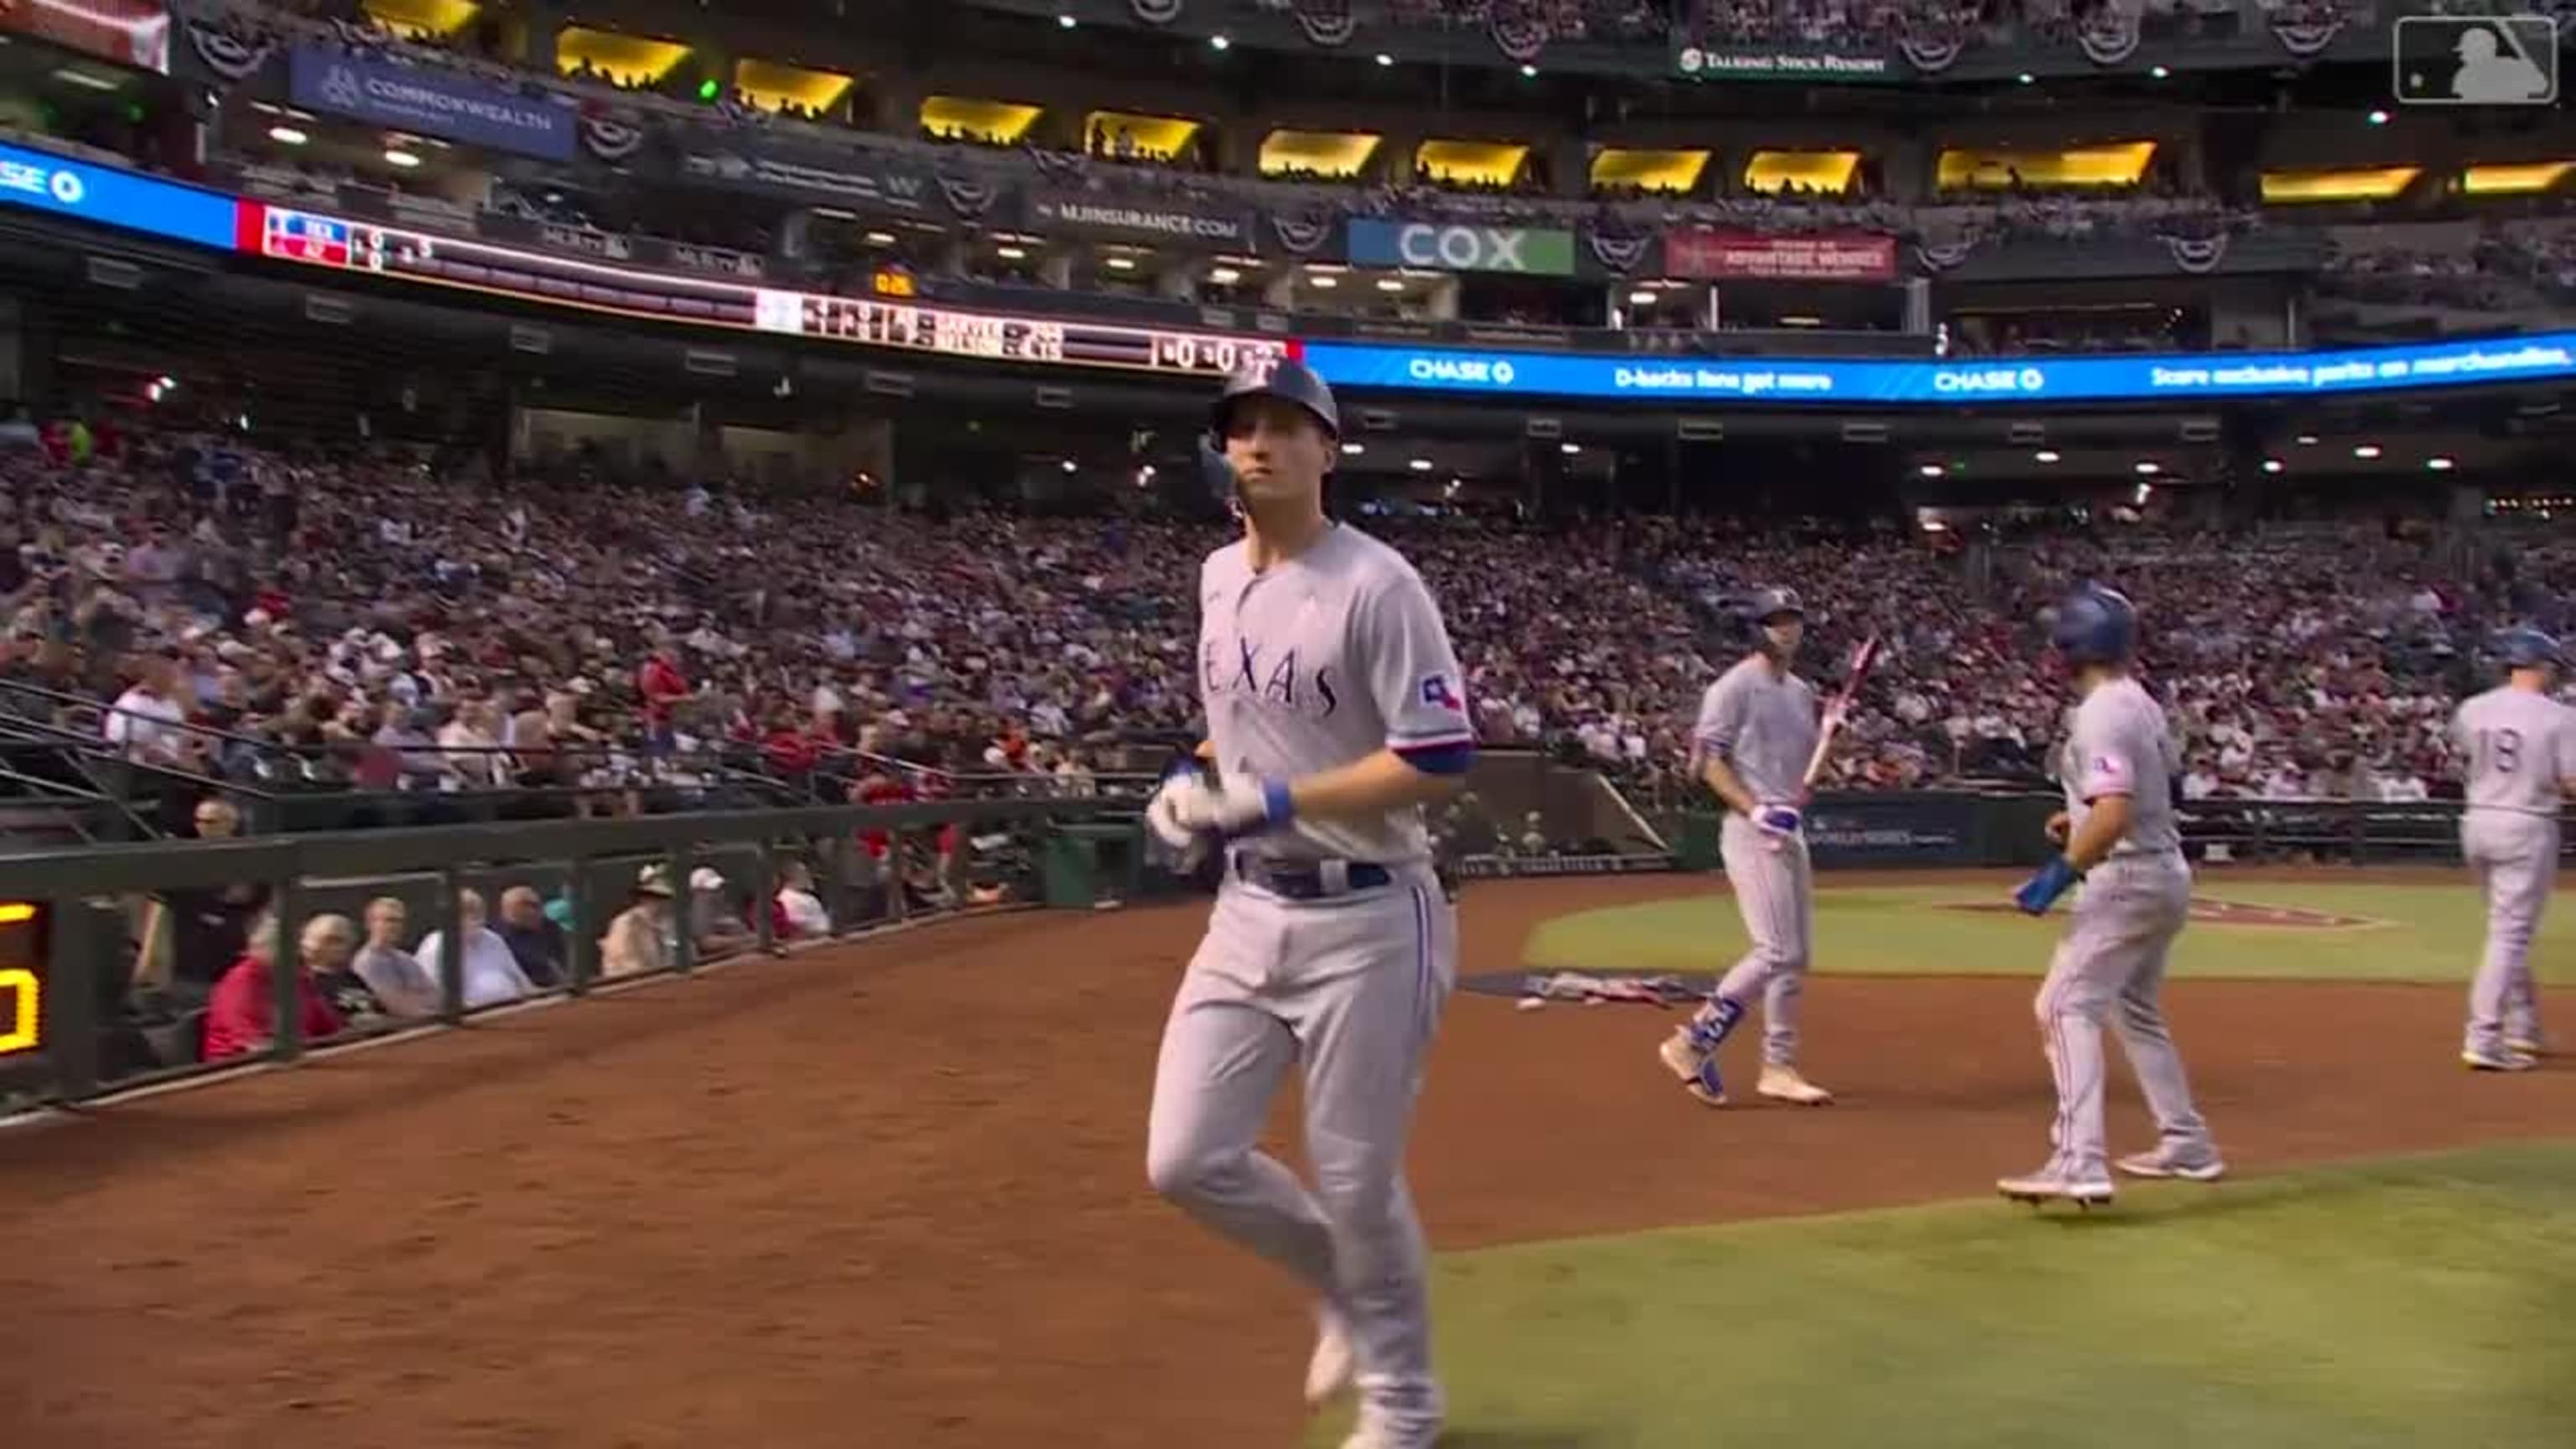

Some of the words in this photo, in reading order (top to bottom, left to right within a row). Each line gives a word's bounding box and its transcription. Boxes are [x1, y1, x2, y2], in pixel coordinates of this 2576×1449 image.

[1705, 52, 1773, 69] TALKING
[1776, 55, 1821, 70] STICK
[1823, 55, 1885, 71] RESORT
[364, 77, 553, 130] COMMONWEALTH
[1399, 223, 1527, 270] COX
[1410, 360, 1489, 382] CHASE
[1935, 371, 2016, 391] CHASE
